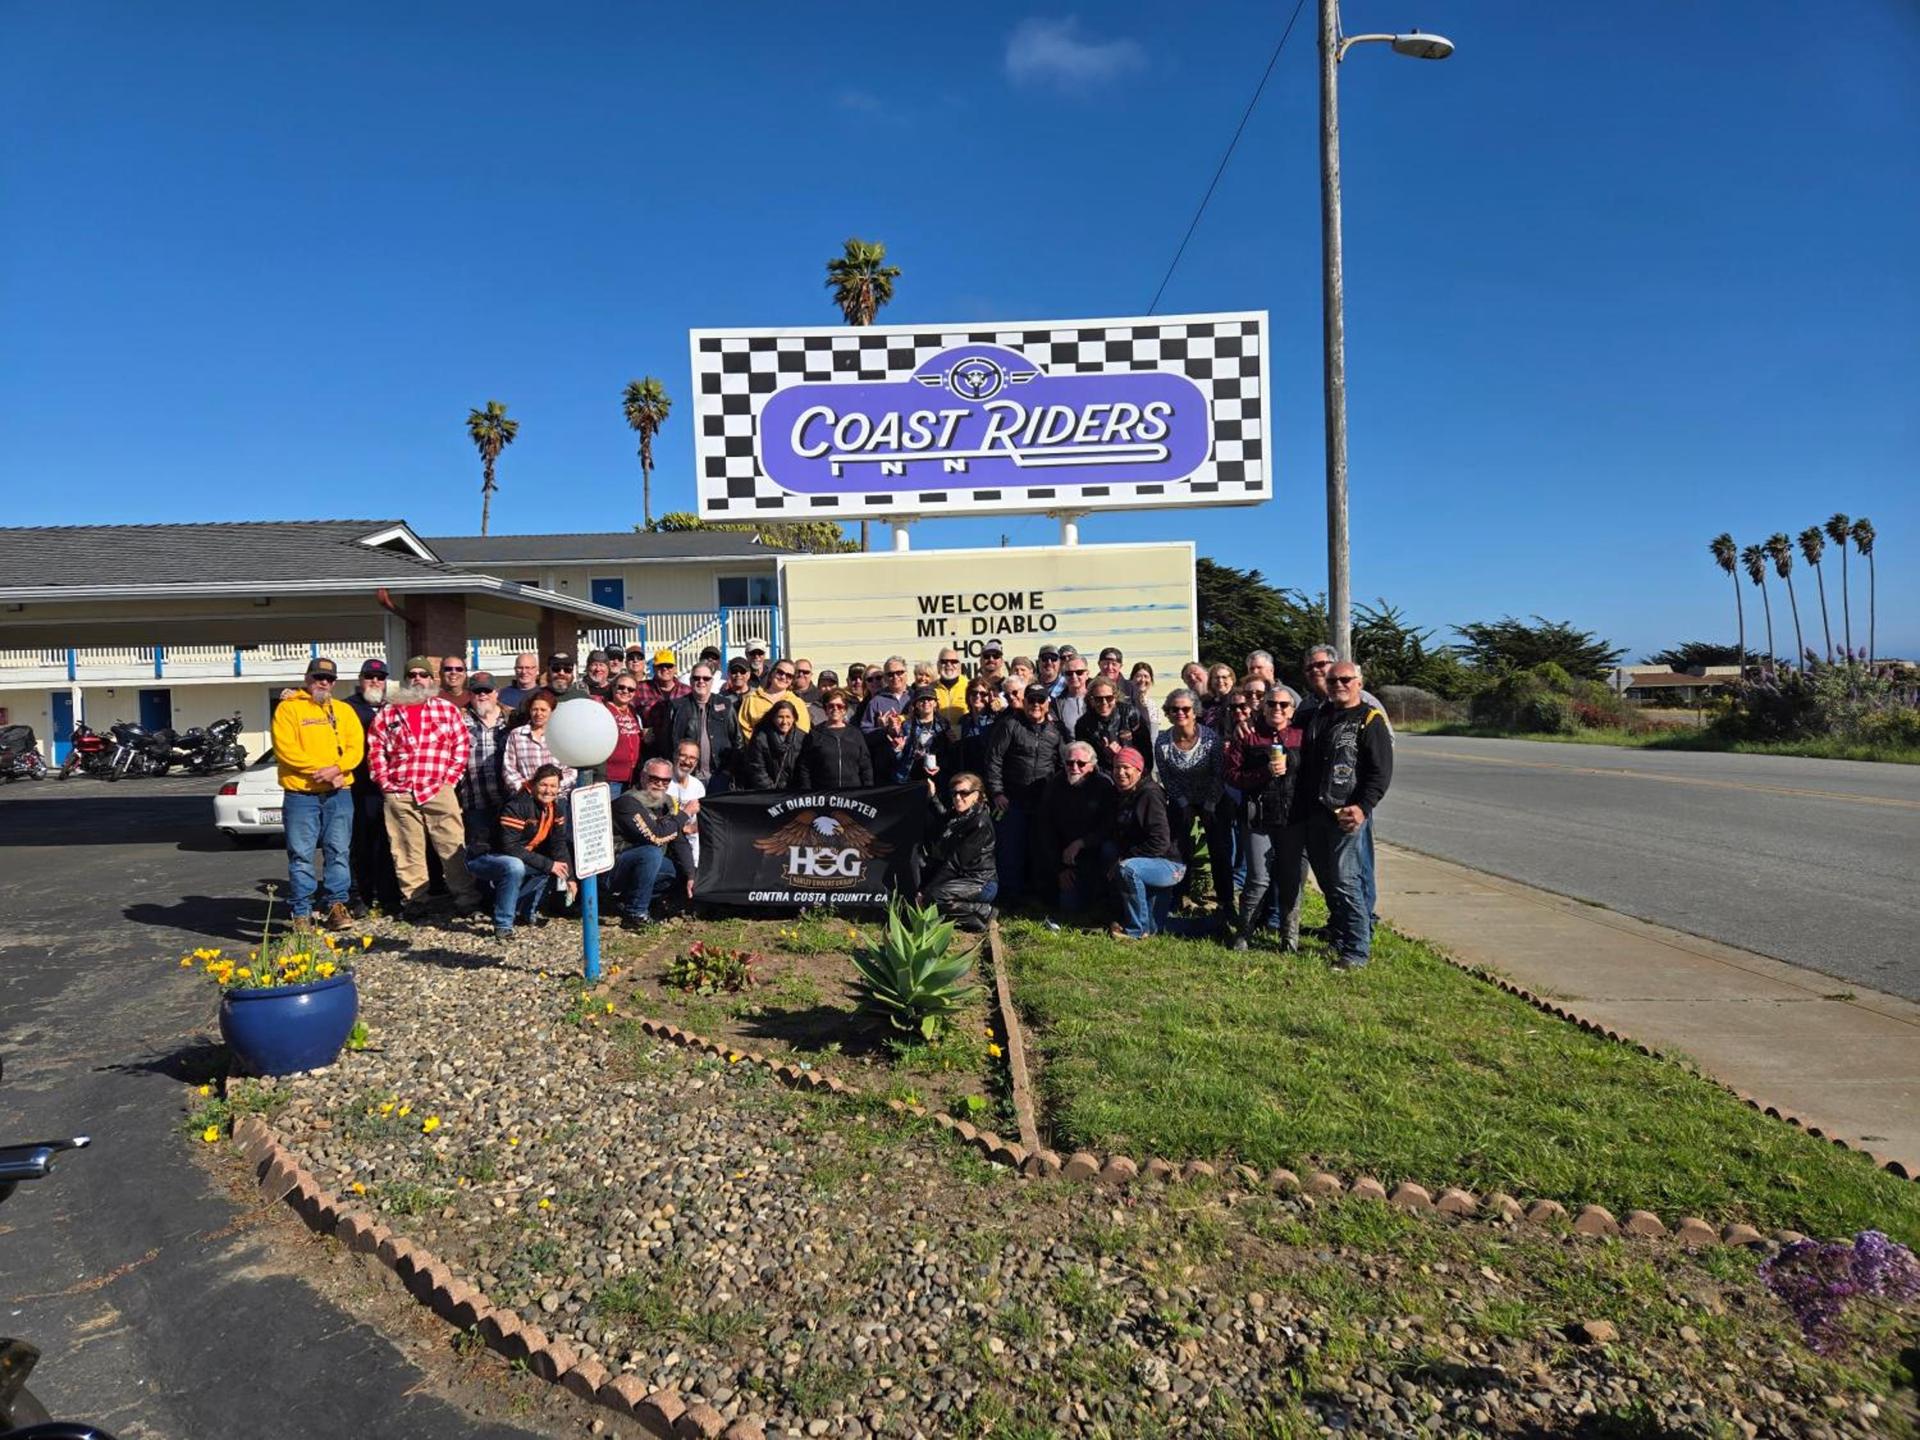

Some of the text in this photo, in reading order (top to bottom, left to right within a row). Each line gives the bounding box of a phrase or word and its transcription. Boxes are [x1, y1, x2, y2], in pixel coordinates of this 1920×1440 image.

[790, 400, 1173, 467] COAST RIDERS
[831, 459, 967, 477] INN
[917, 591, 1044, 614] WELCOME
[917, 613, 1057, 637] MT. DIABLO
[767, 795, 877, 818] MT DIABLO CHAPTER
[788, 845, 862, 876] HOG
[748, 891, 889, 903] CONTRA COSTA COUNTY CA
